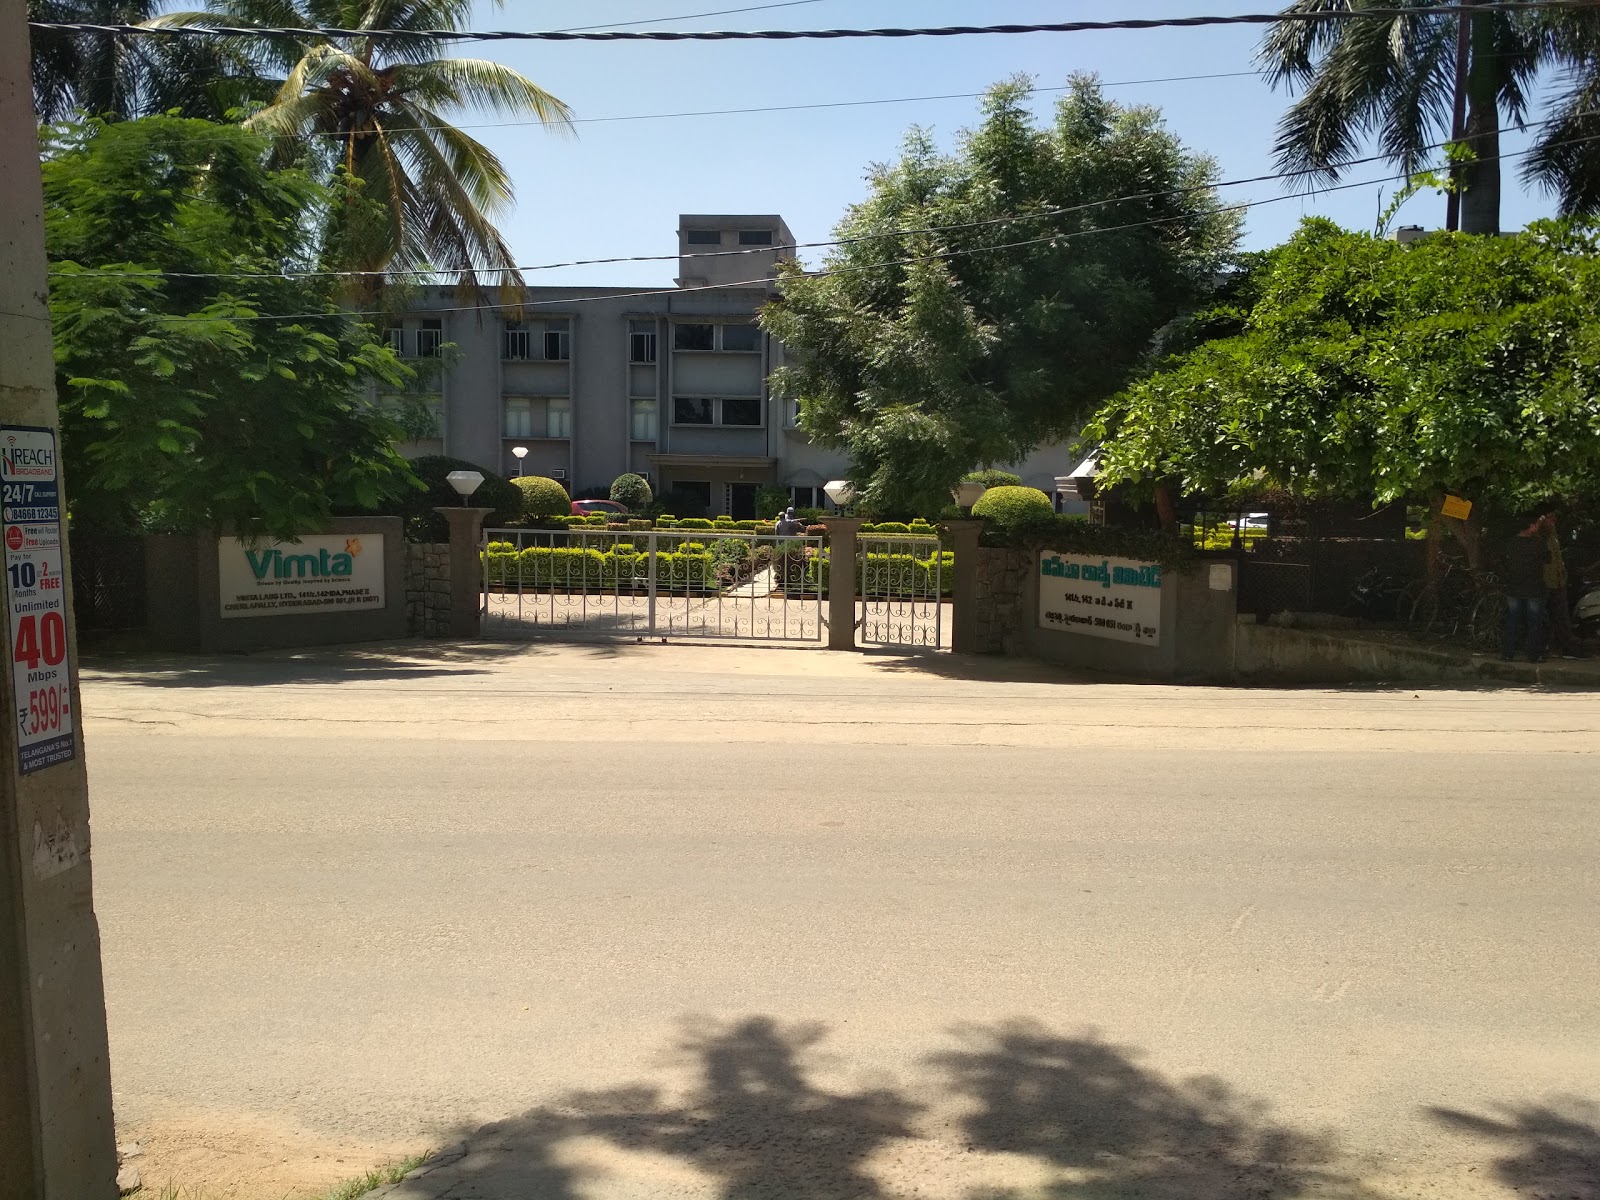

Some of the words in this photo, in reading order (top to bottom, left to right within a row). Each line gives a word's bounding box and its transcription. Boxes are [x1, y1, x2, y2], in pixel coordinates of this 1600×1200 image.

[3, 484, 34, 504] 24/7
[37, 508, 57, 518] 12345
[26, 538, 38, 546] Free
[39, 538, 58, 546] Uploads
[245, 548, 353, 579] Vimta
[8, 562, 36, 589] 10
[42, 562, 48, 577] 2
[40, 578, 60, 590] FREE
[15, 599, 59, 613] Unlimited
[1081, 594, 1093, 604] 142
[15, 612, 65, 669] 40
[28, 670, 57, 683] Mbps
[21, 742, 60, 759] TELANGANA'S
[29, 757, 46, 768] MOST
[47, 749, 72, 763] TRUSTED
